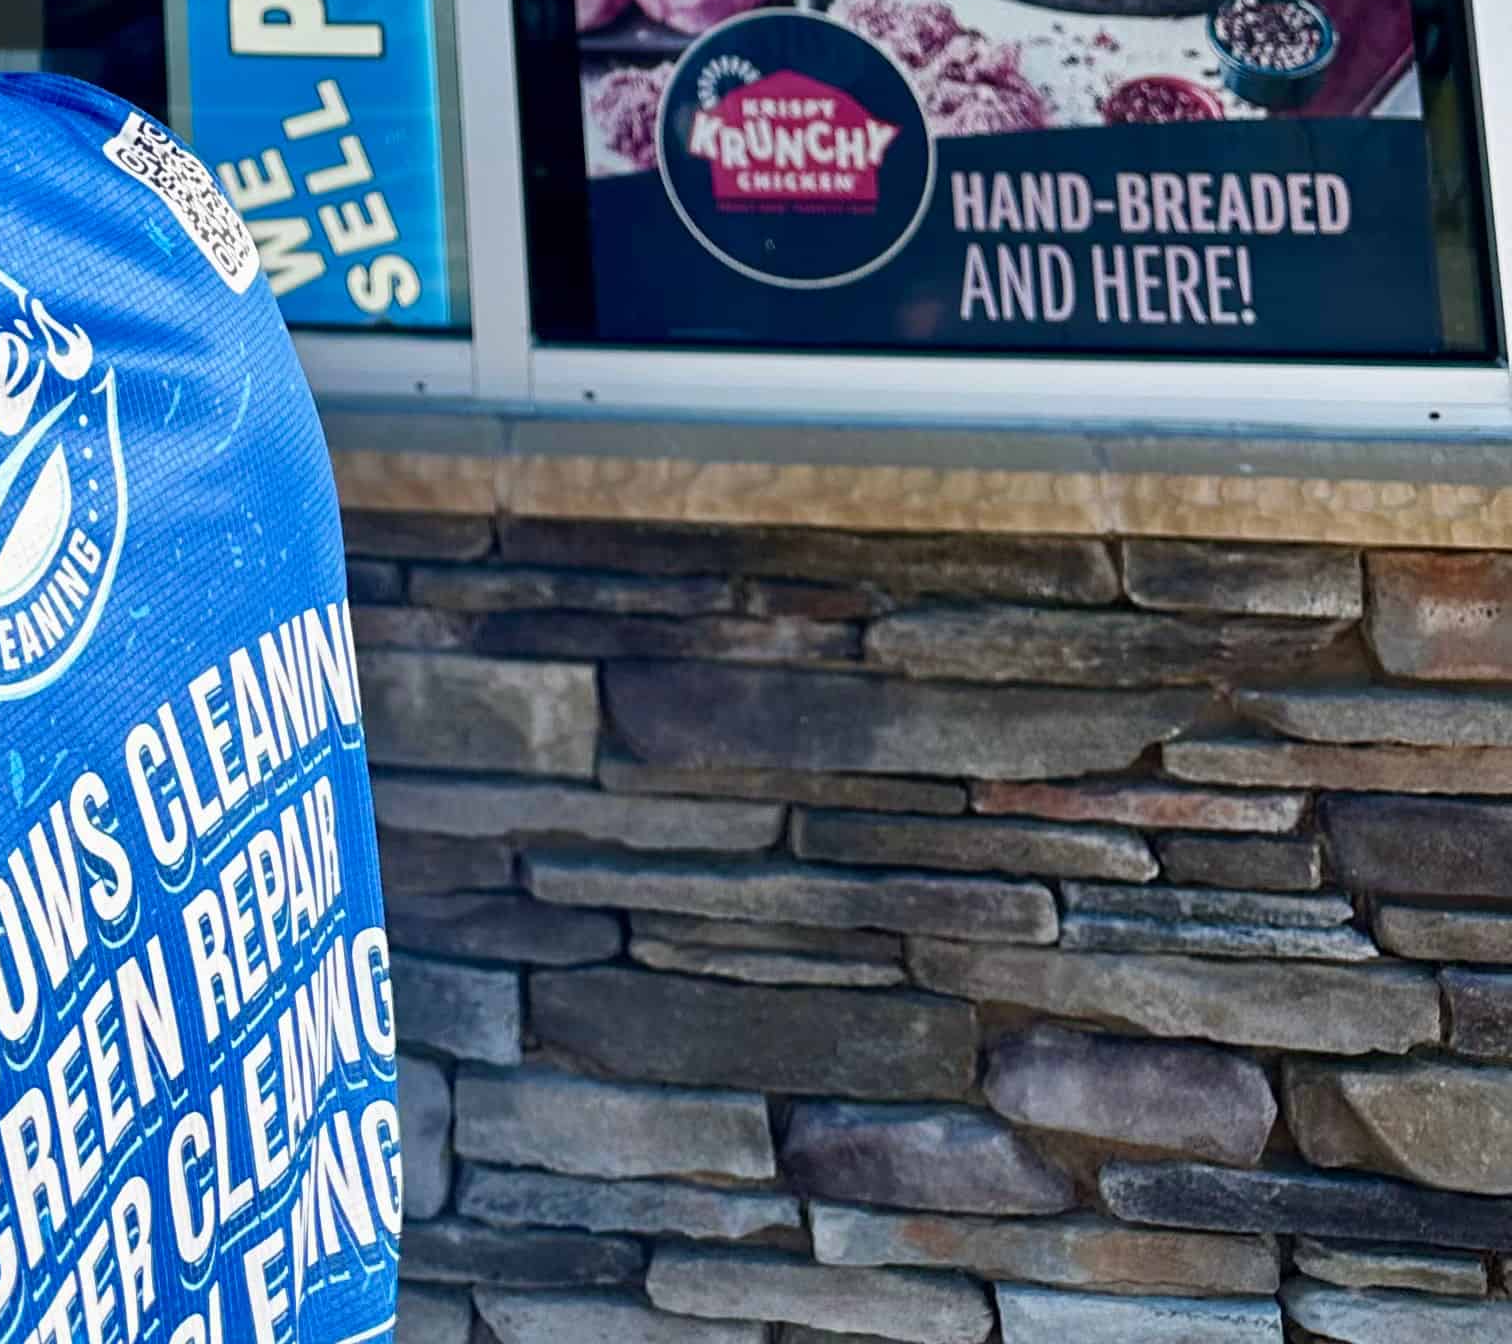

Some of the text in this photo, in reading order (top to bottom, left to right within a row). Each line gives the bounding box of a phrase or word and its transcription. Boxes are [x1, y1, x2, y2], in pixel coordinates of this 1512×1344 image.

[740, 98, 836, 119] KRISPY
[216, 148, 327, 297] WE
[283, 79, 421, 312] SELL
[737, 170, 856, 192] CHICKEN
[951, 171, 1352, 236] HAND-BREADED
[959, 244, 1257, 326] AND HERE!
[125, 597, 362, 868] CLEANIN
[182, 775, 342, 1044] REPAIR
